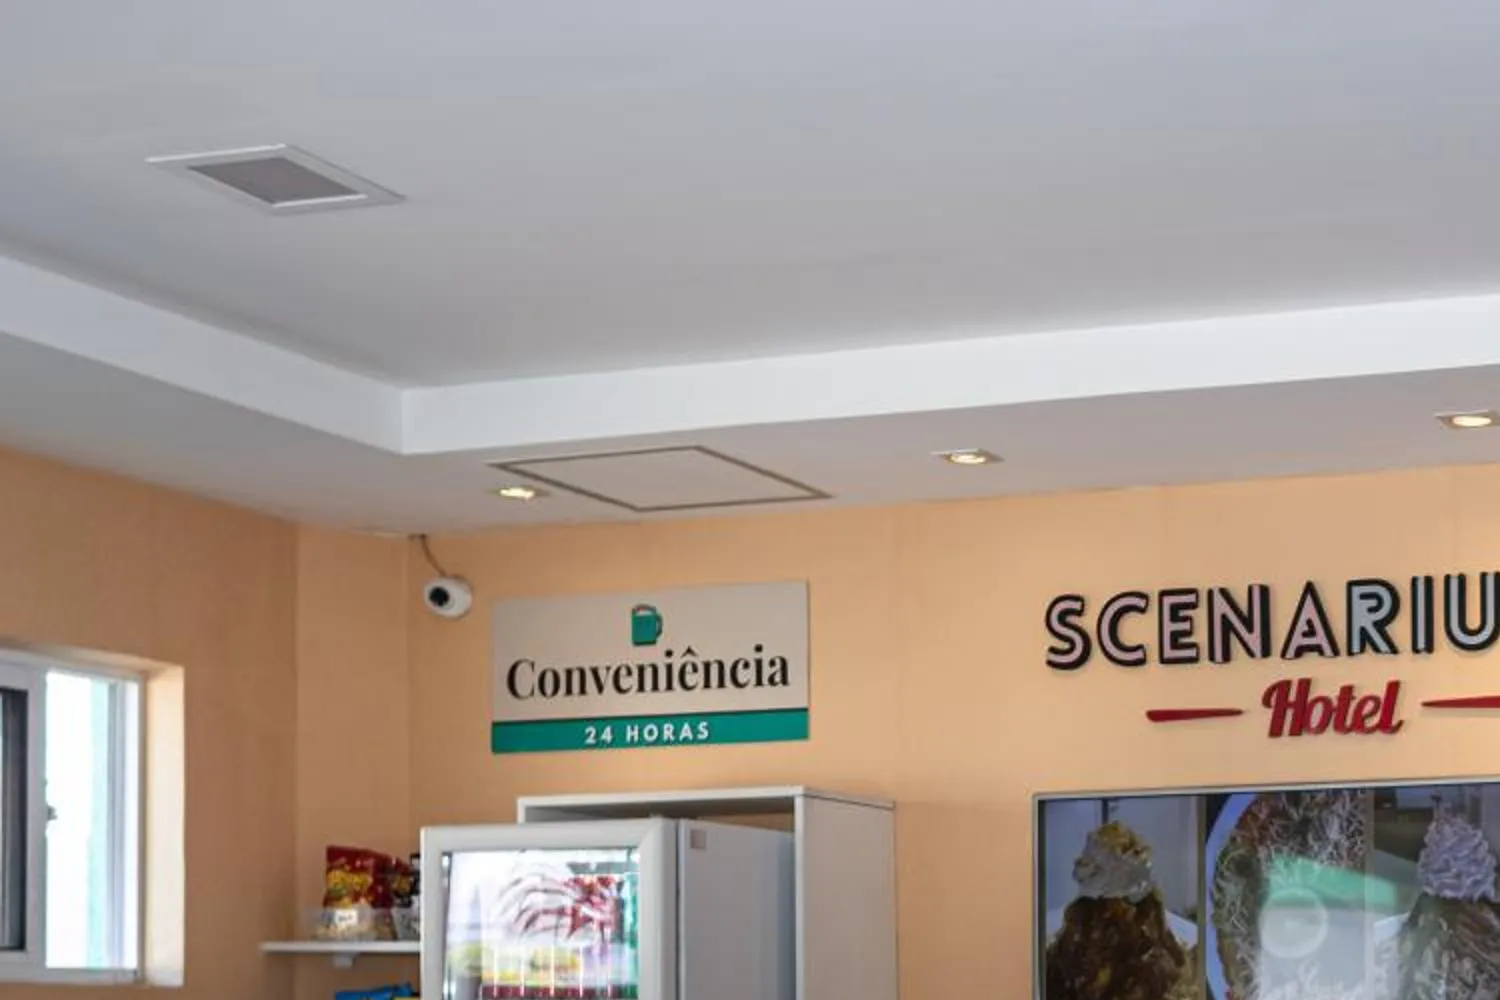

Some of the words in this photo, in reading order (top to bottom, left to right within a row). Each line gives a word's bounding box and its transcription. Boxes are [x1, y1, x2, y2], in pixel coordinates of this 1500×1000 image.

[506, 644, 790, 700] Conveniência
[584, 725, 613, 745] 24
[626, 721, 711, 744] HORAS
[1262, 677, 1404, 738] Hotel
